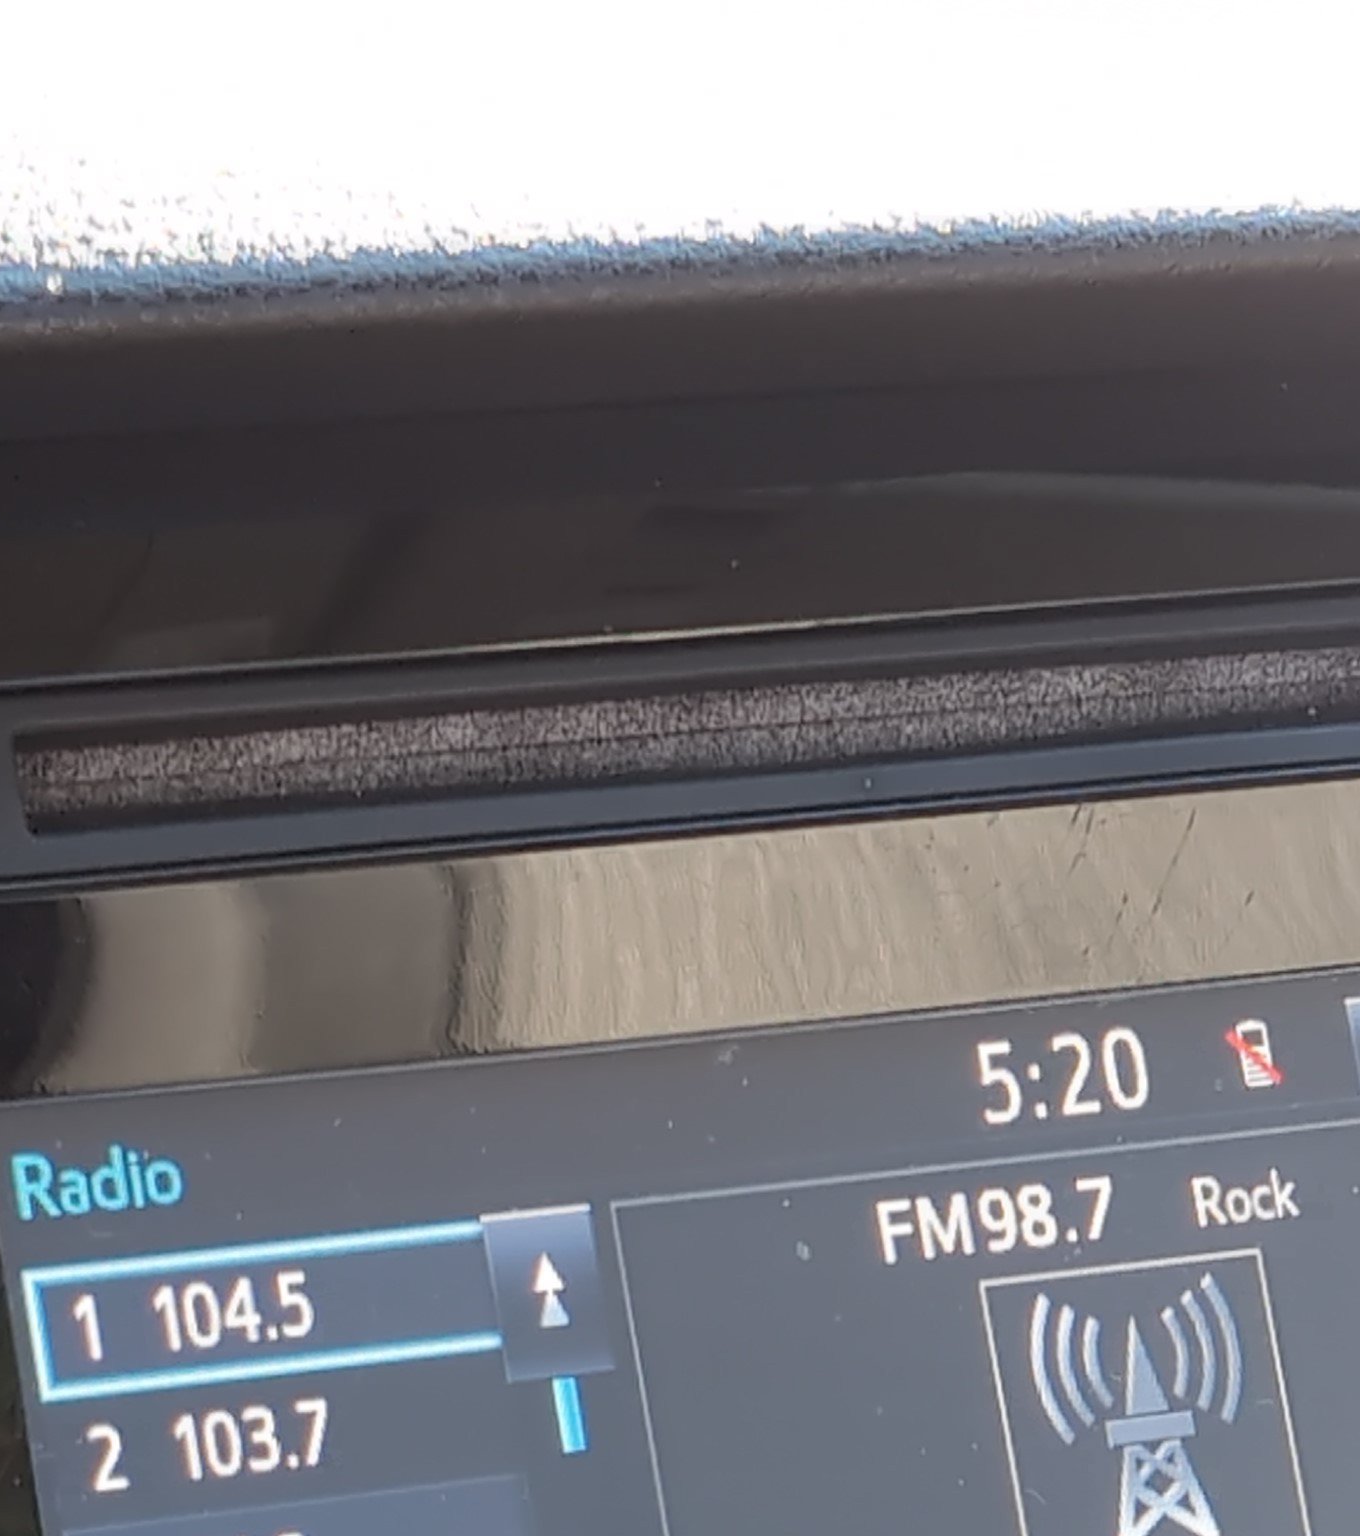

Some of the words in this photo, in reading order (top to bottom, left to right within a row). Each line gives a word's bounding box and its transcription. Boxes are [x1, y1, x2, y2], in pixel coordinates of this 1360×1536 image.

[976, 1027, 1151, 1125] 5:20
[11, 1145, 184, 1220] Radio
[1190, 1169, 1301, 1227] Rock
[73, 1294, 103, 1361] 1
[152, 1270, 316, 1353] 104.5
[86, 1424, 129, 1492] 2
[174, 1397, 330, 1482] 103.7
